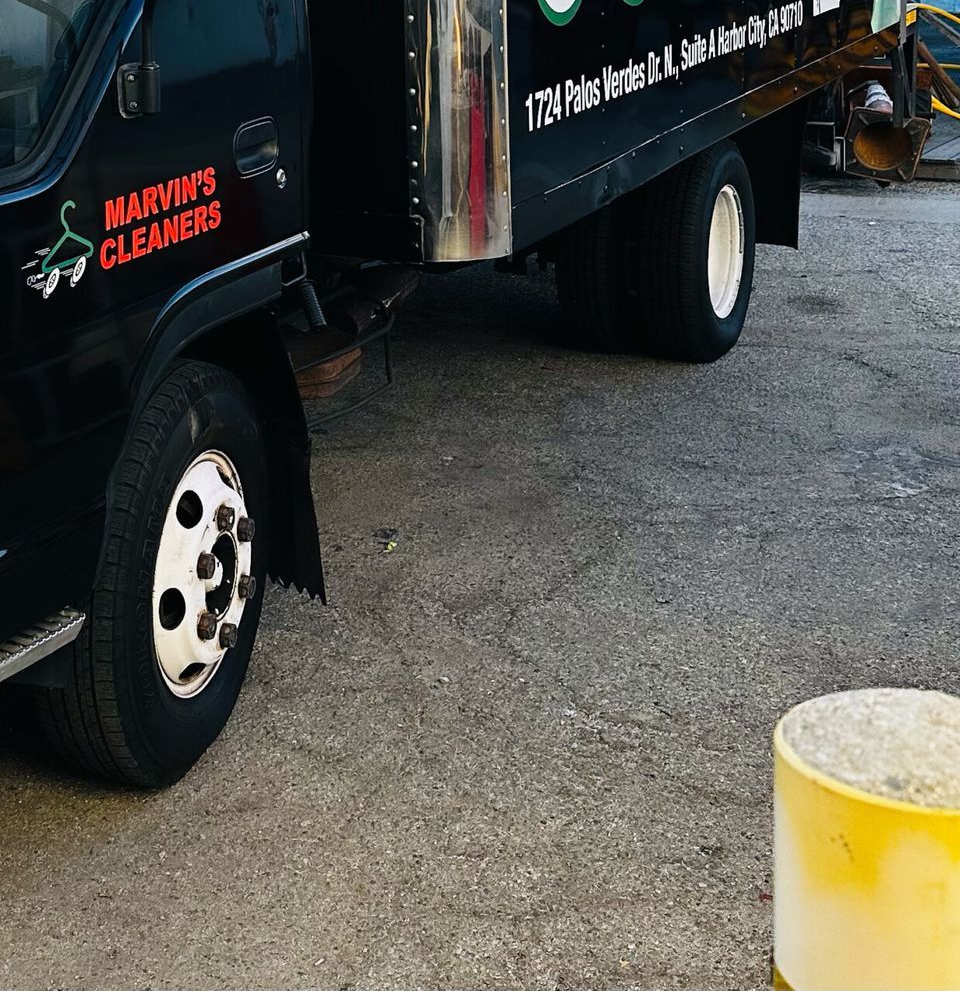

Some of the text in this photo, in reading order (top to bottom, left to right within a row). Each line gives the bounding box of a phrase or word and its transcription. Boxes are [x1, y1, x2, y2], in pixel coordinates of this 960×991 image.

[525, 83, 562, 132] 1724
[565, 74, 600, 117] Palos
[603, 59, 645, 101] Verdes
[648, 52, 662, 85] Dr.
[681, 33, 707, 71] Suite
[708, 29, 716, 59] A
[718, 18, 746, 56] Harbor
[748, 16, 767, 49] City,
[768, 9, 779, 39] CA
[780, 0, 804, 35] 90710
[104, 166, 216, 231] MARVIN'S
[100, 200, 222, 270] CLEANERS
